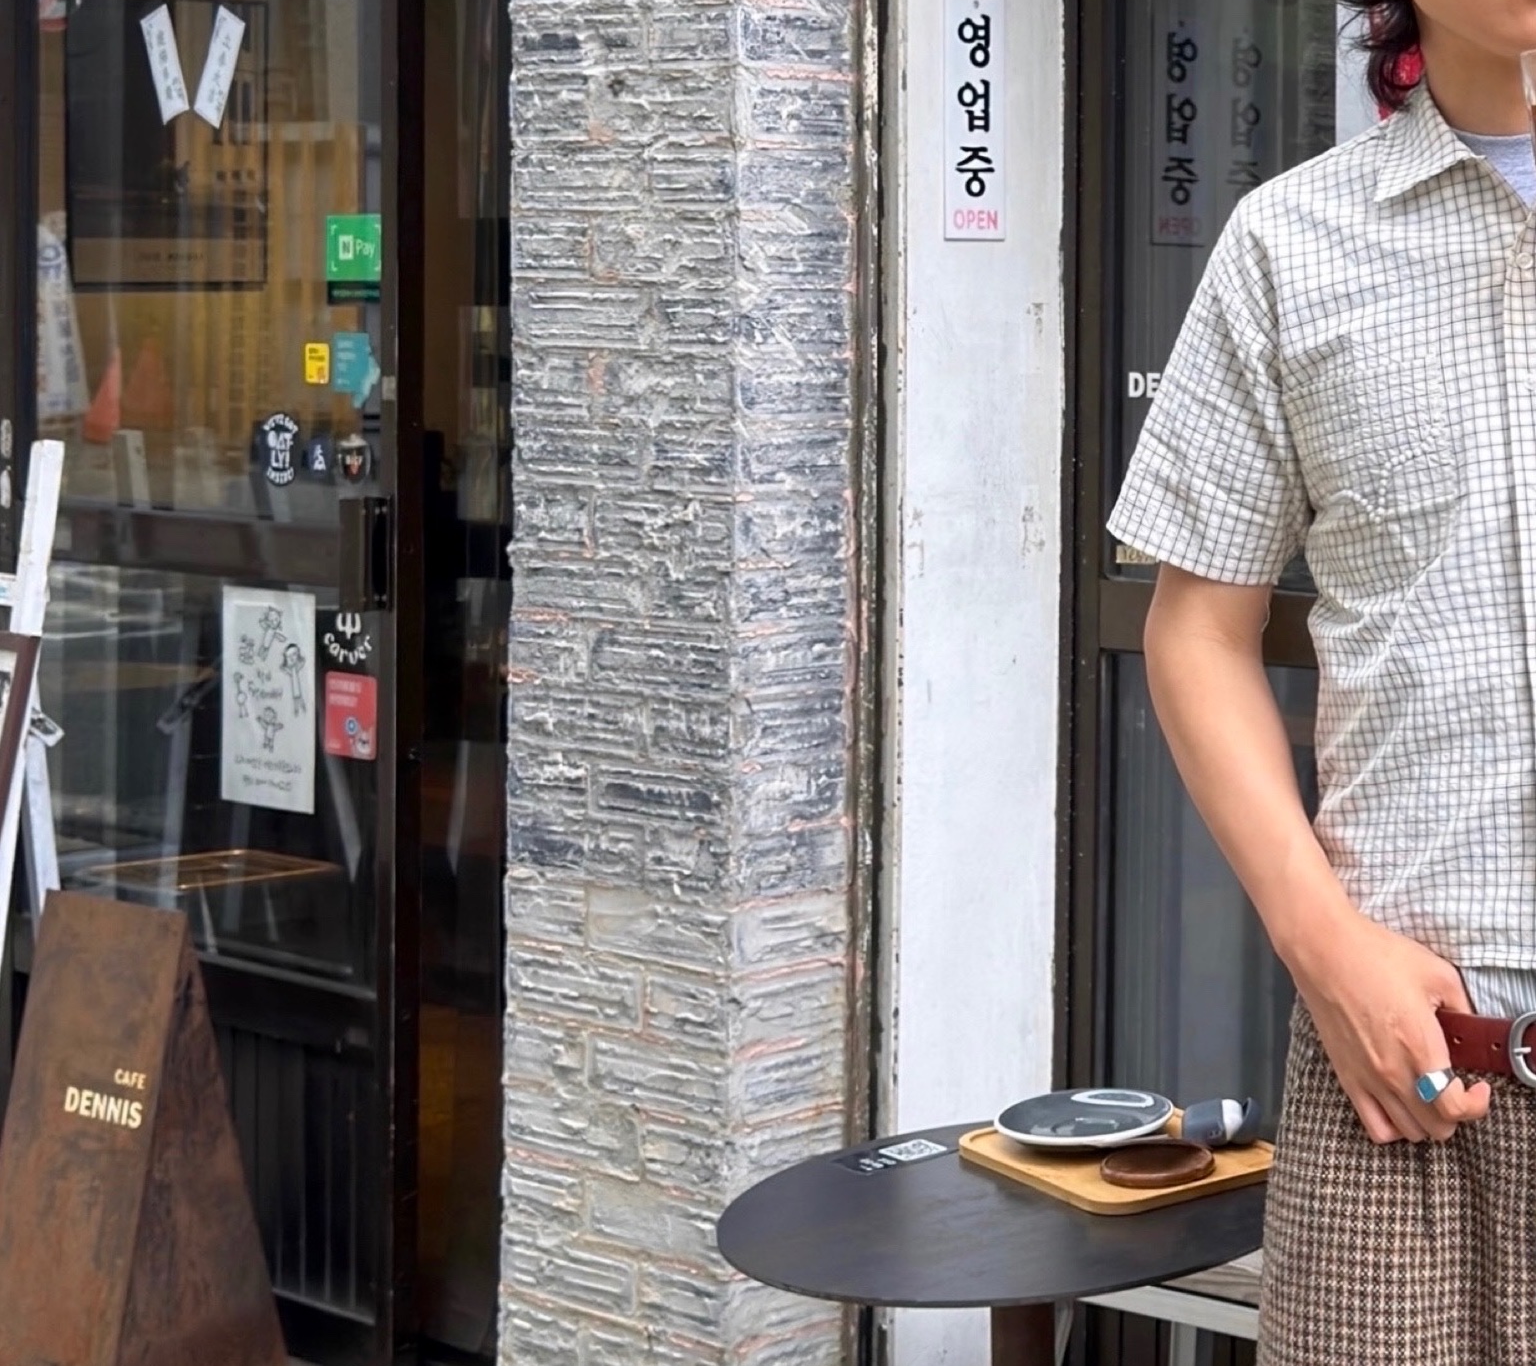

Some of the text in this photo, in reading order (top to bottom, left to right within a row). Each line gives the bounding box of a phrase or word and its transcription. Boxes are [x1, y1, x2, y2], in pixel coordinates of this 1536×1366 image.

[955, 14, 995, 197] 영업중
[953, 209, 998, 231] OPEN
[356, 239, 376, 259] Pay
[114, 1068, 146, 1090] CAFE
[64, 1086, 143, 1129] DENNIS
